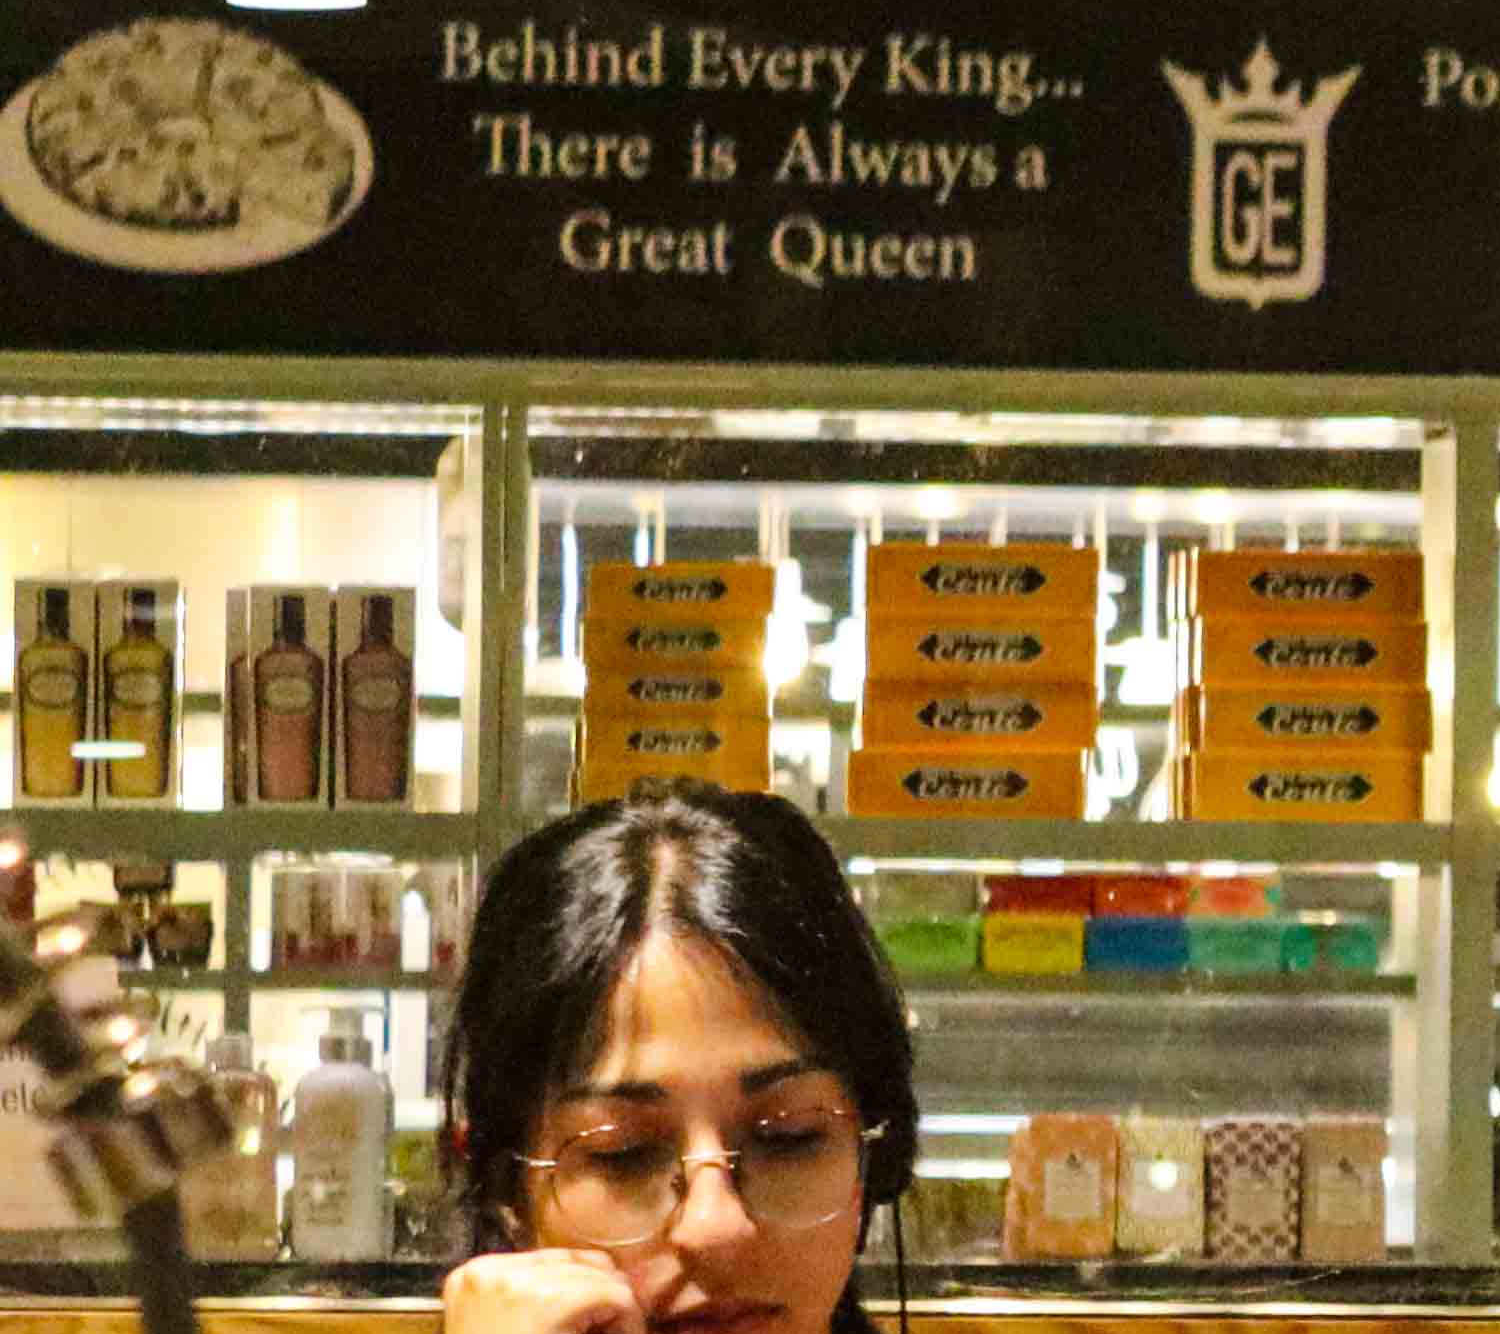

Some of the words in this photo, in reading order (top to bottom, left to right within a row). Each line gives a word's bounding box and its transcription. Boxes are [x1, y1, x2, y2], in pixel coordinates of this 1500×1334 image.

[440, 21, 666, 86] Behind
[686, 27, 864, 111] Every
[473, 113, 652, 178] There
[690, 123, 738, 181] is
[774, 121, 998, 204] Always
[1014, 144, 1048, 189] a
[559, 209, 732, 274] Great
[768, 213, 976, 288] Queen
